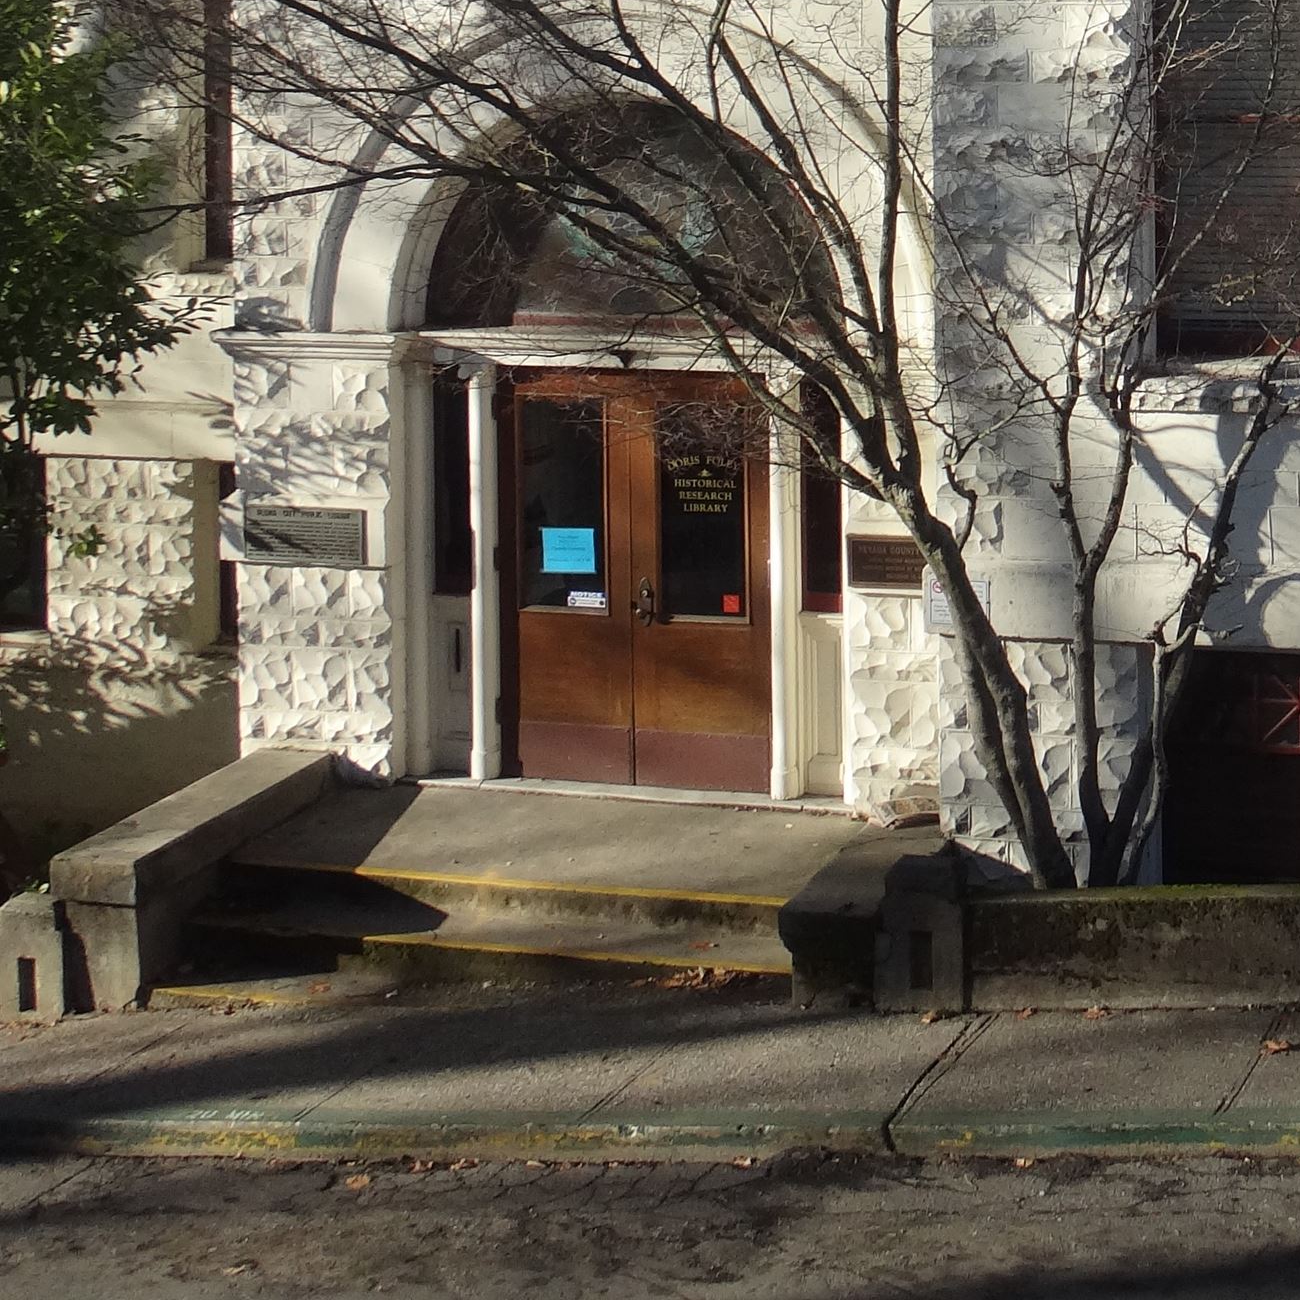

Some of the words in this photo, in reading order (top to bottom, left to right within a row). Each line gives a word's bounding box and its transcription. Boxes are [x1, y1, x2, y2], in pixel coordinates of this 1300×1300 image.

[667, 455, 700, 471] DORIS
[674, 478, 737, 489] HISTORICAL
[679, 490, 733, 501] RESEARCH
[683, 503, 729, 513] LIBRARY
[570, 591, 603, 599] NOTICE
